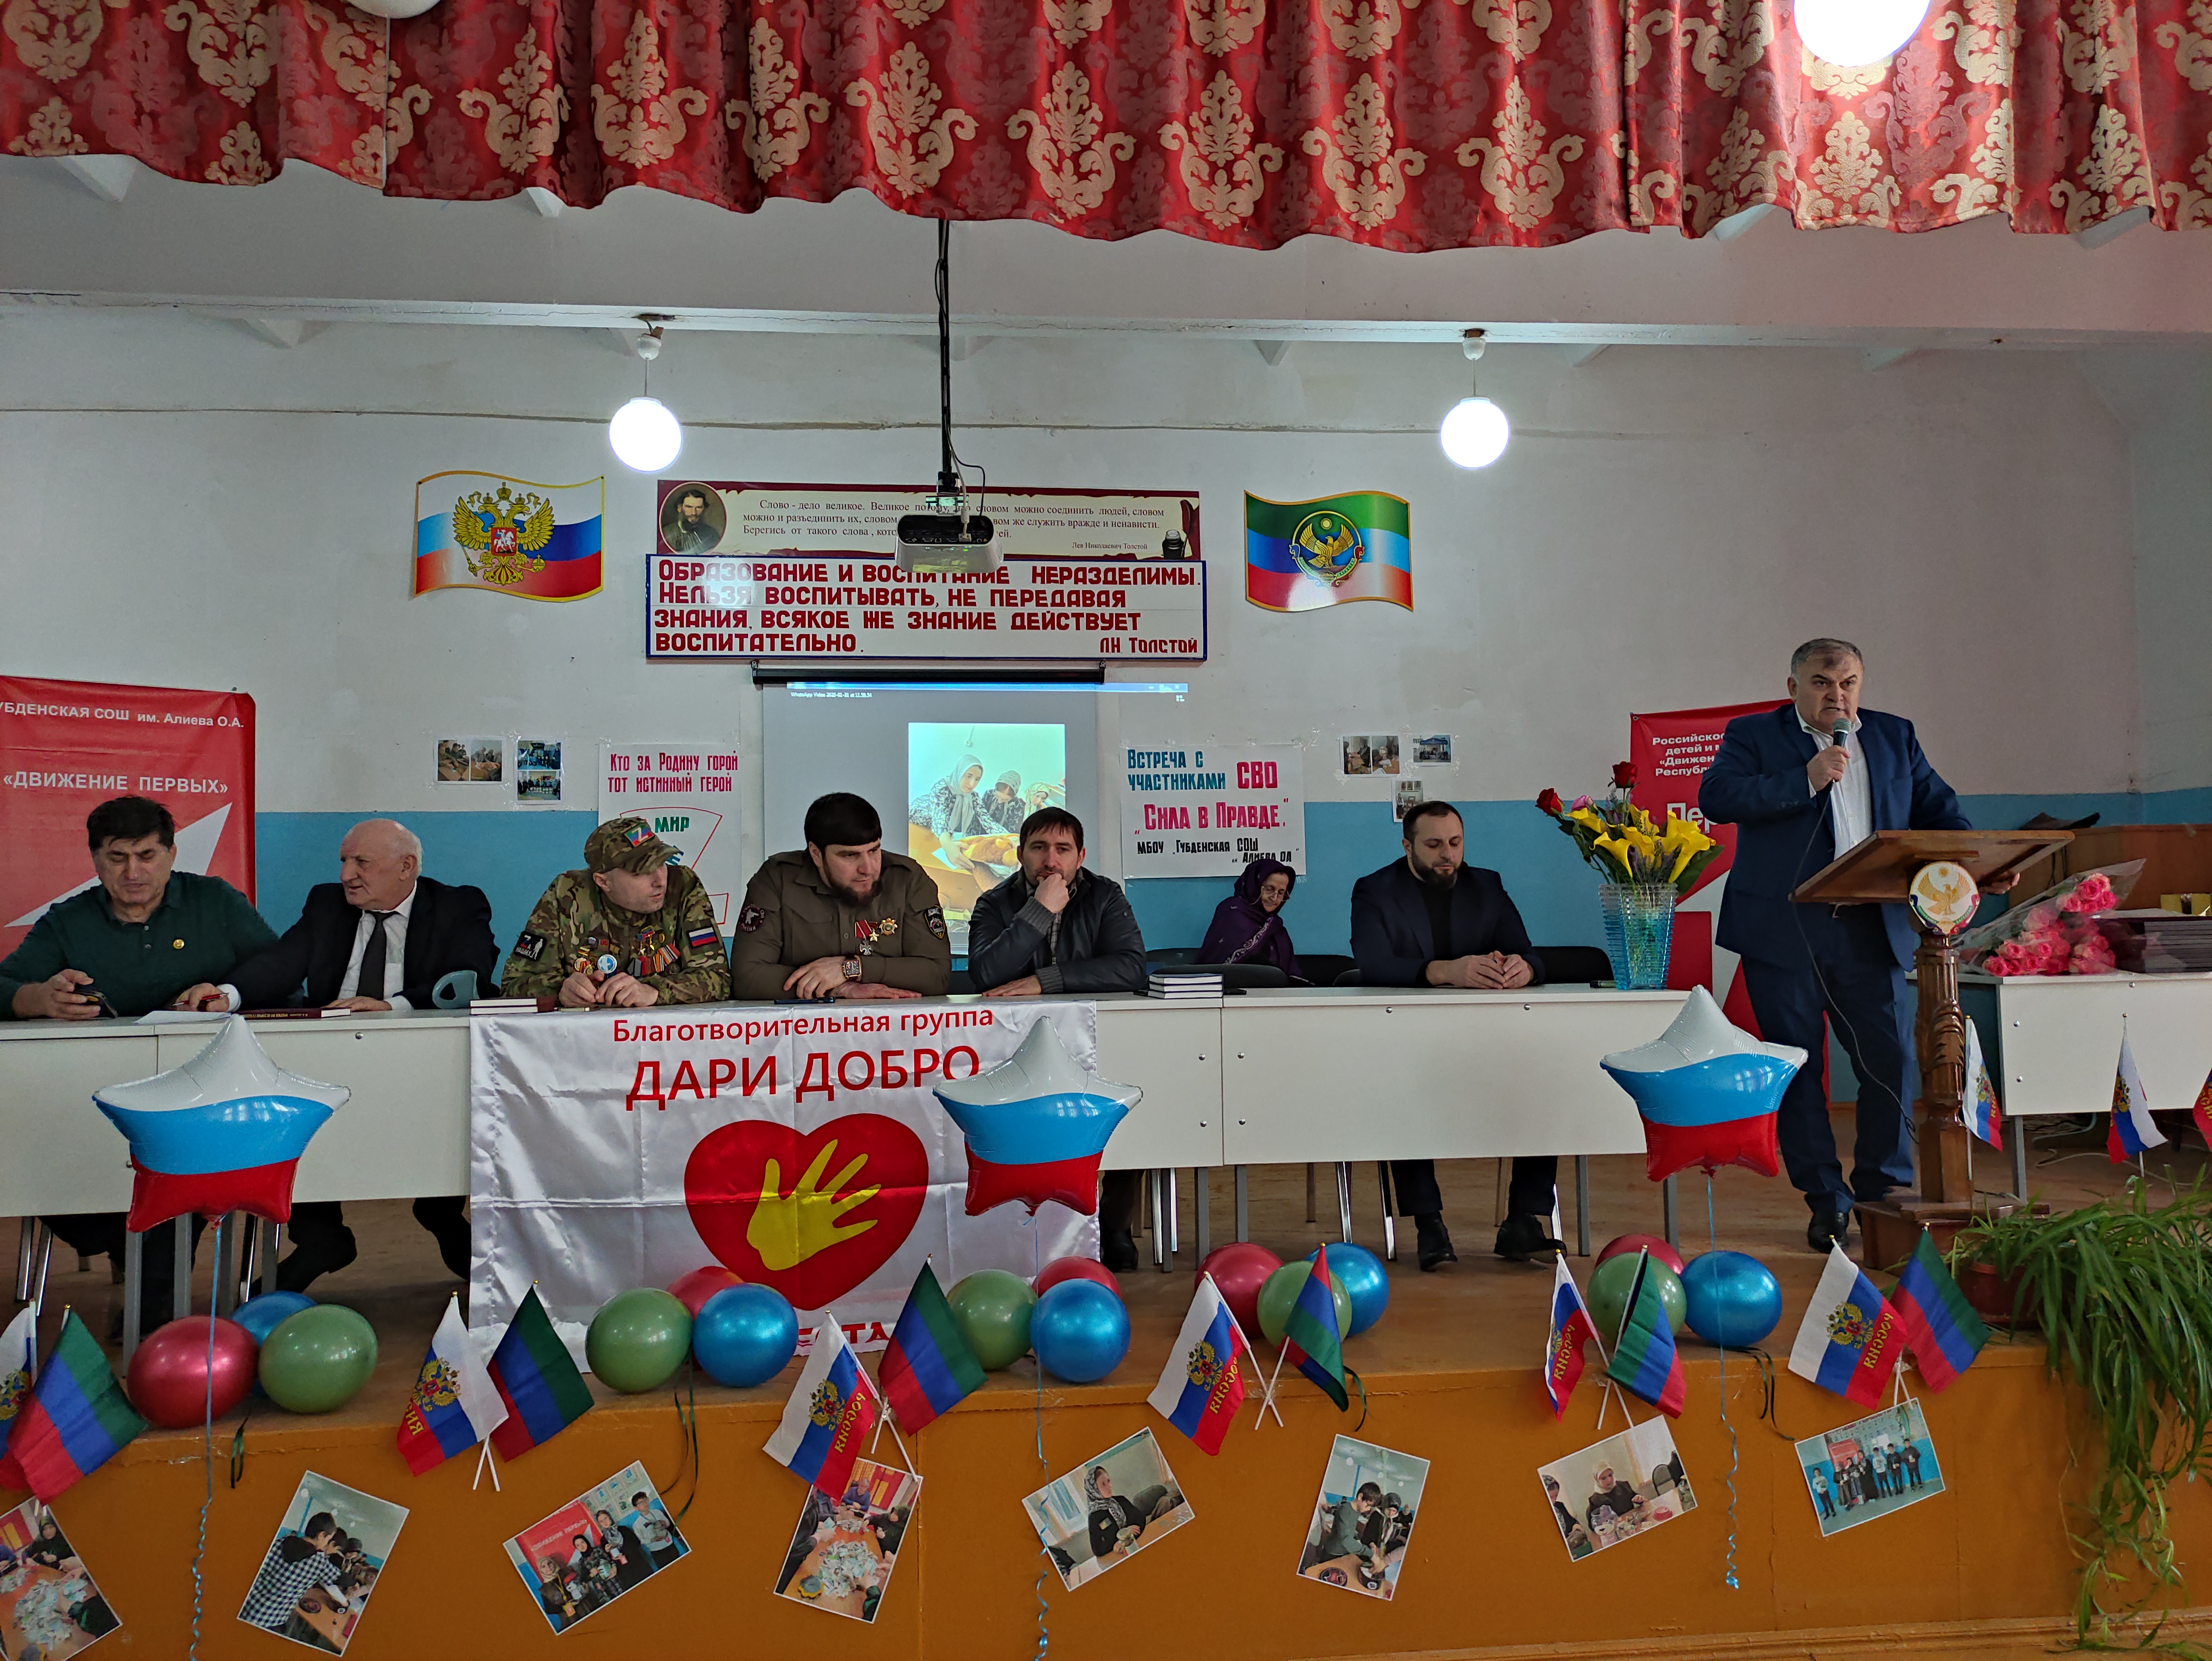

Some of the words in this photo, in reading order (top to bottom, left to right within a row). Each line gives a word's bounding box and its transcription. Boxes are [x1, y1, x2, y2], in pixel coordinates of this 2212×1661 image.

[760, 500, 789, 510] Слово
[798, 502, 820, 511] дело
[826, 502, 865, 510] великое.
[871, 502, 909, 511] Великое
[1099, 508, 1130, 518] людей,
[743, 525, 785, 536] Берегись
[786, 514, 845, 524] разъединить
[848, 515, 862, 524] их,
[1027, 519, 1065, 529] служить
[1068, 520, 1100, 529] вражде
[1111, 520, 1160, 529] ненависти.
[839, 565, 853, 582] И
[1031, 567, 1201, 586] НЕРАЗДЕЛИМЫ.
[765, 587, 939, 608] ВОСПИТЫВАТЬ,
[948, 589, 976, 607] НЕ
[990, 589, 1127, 608] ПЕРЕДАВАЯ
[654, 609, 752, 630] ЗНАНИЯ,
[761, 610, 850, 630] ВСЯКОЕ
[863, 611, 895, 629] ЖЕ
[907, 611, 996, 631] ЗНАНИЕ
[1010, 610, 1141, 631] ДЕЙСТВУЕТ
[655, 633, 864, 653] ВОСПИТАТЕЛЬНО.
[94, 708, 129, 720] СОШ
[137, 713, 160, 723] им.
[164, 713, 214, 726] Алиева
[218, 716, 244, 728] О.А.
[1665, 744, 1702, 756] детей
[1655, 765, 1710, 777] Республ
[1659, 755, 1714, 767] «Движен
[3, 771, 128, 790] «ДВИЖЕНИЕ
[139, 776, 229, 794] ПЕРВЫХ»
[1237, 761, 1278, 789] СВО
[1667, 802, 1717, 833] Пер
[1237, 838, 1259, 852] СОШ
[614, 1014, 890, 1044] Благотворительная
[901, 1009, 993, 1036] группа
[626, 1055, 776, 1111] ДАРИ
[796, 1045, 979, 1103] ДОБРО
